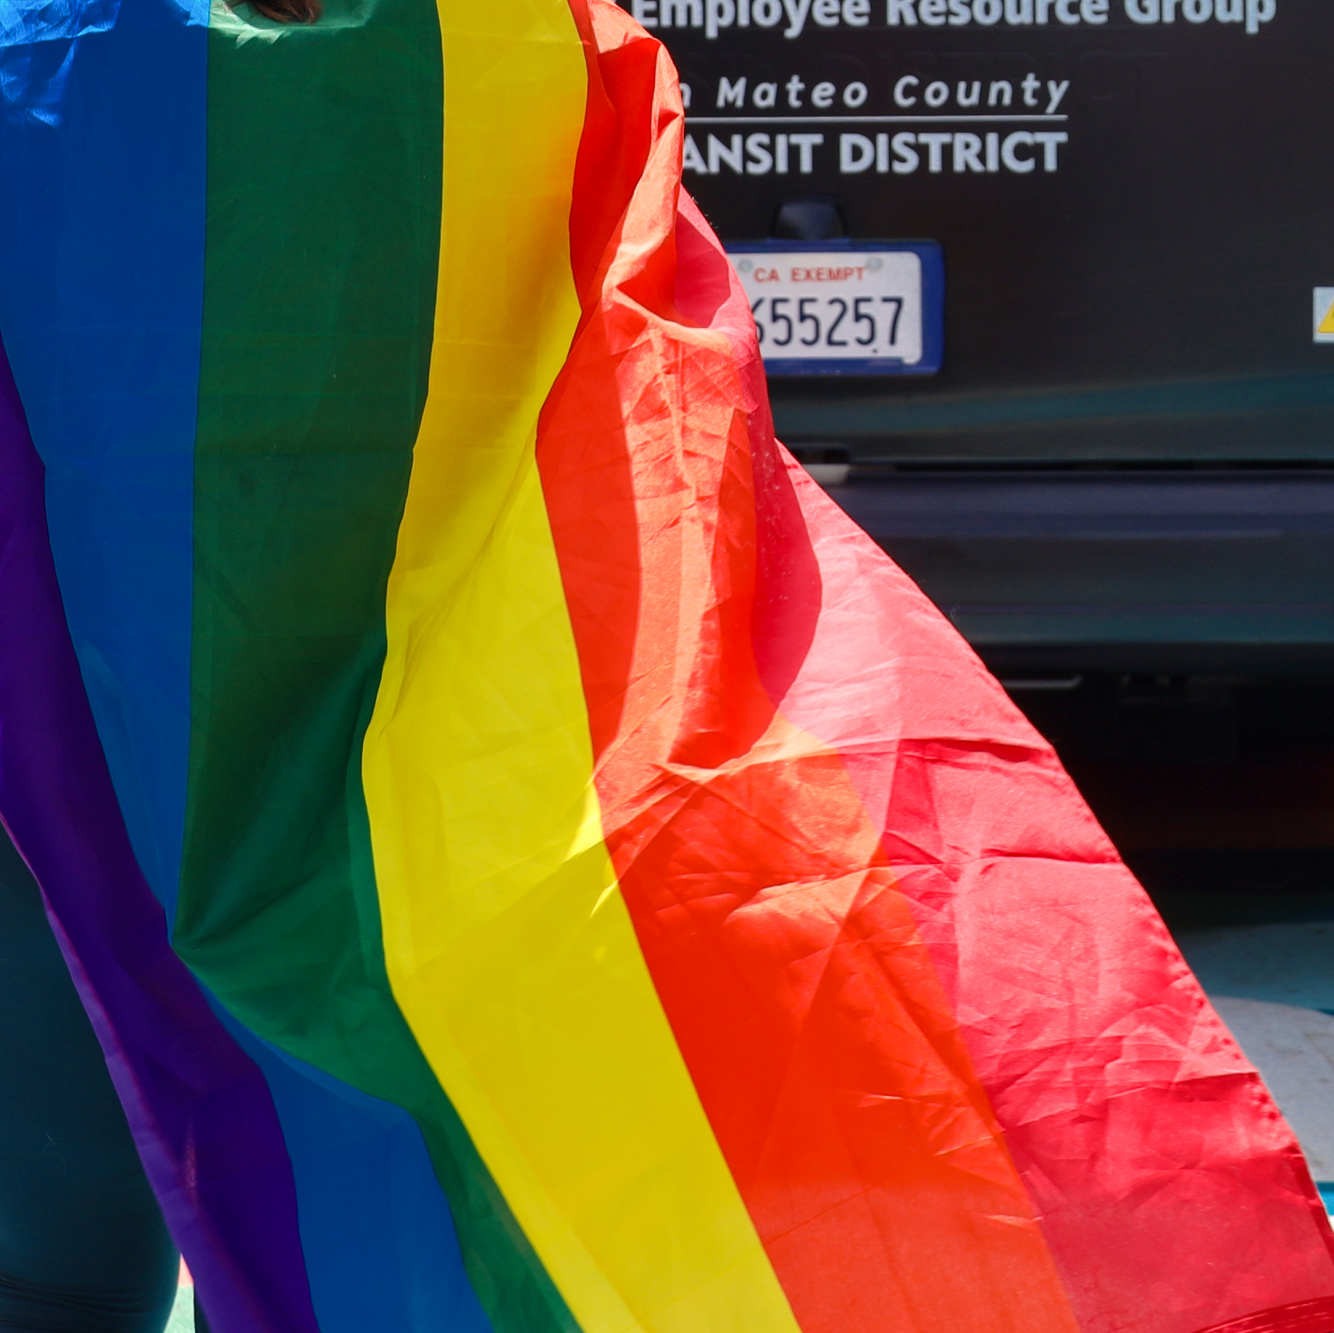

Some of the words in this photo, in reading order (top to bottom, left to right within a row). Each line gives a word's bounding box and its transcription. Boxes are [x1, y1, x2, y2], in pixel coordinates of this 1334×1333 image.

[716, 74, 869, 109] Mateo
[893, 72, 1070, 115] County
[682, 132, 824, 175] ANSIT
[839, 130, 1069, 175] DISTRICT
[753, 267, 780, 283] CA
[790, 267, 866, 282] EXEMPT
